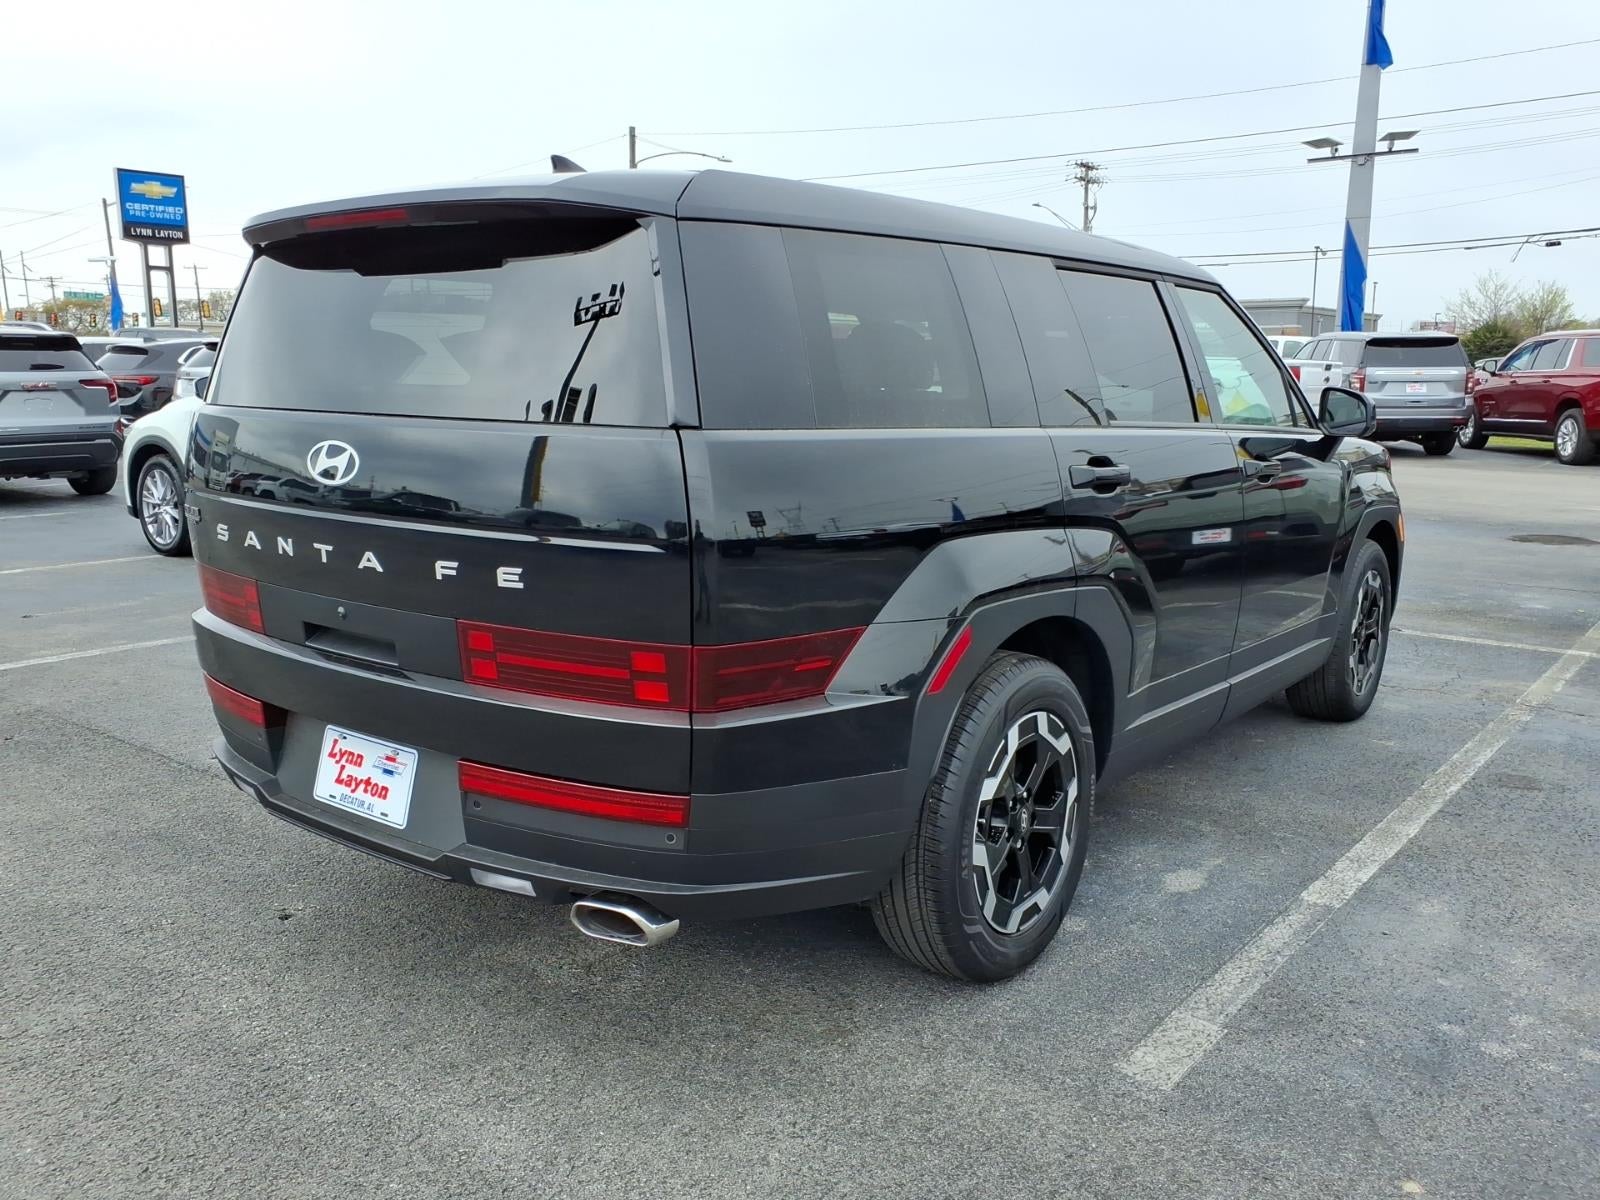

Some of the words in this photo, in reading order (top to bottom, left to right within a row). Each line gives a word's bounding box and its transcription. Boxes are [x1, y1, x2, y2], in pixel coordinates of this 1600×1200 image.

[126, 203, 183, 214] CERTIFIED
[129, 210, 182, 220] PRE-OWNED
[131, 227, 152, 236] LYNN
[155, 230, 183, 239] LAYTON
[216, 523, 384, 573] SANTA
[435, 560, 525, 589] FE
[327, 738, 364, 768] Lynn
[334, 764, 390, 801] Layton
[366, 802, 375, 813] AL
